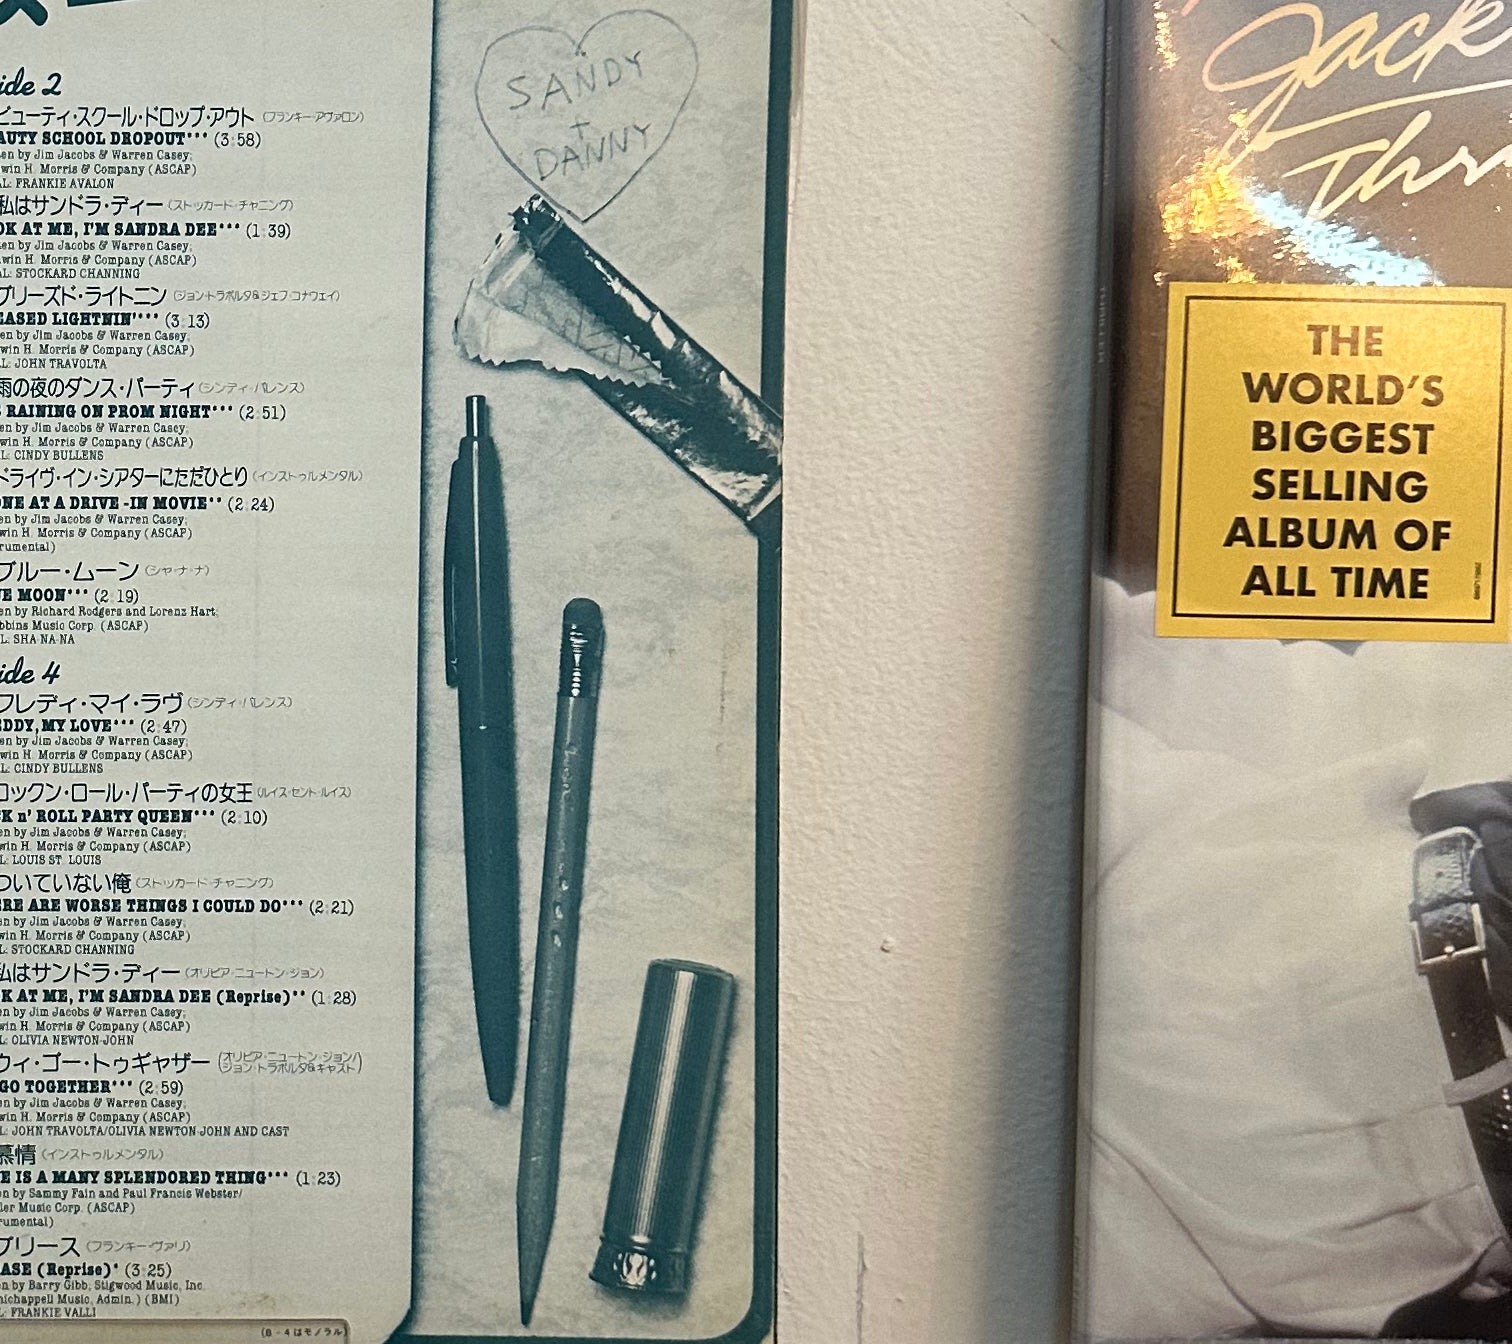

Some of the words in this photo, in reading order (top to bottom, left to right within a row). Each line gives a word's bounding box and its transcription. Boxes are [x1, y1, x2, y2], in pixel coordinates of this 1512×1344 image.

[42, 73, 63, 96] 2
[506, 49, 644, 111] SANDY
[42, 132, 106, 145] SCHOOL
[532, 122, 651, 182] DANNY
[1306, 324, 1383, 357] THE
[1241, 371, 1444, 407] WORLD'S
[6, 404, 76, 418] RAINING
[81, 404, 103, 418] ON
[107, 404, 154, 418] PROM
[1251, 420, 1435, 455] BIGGEST
[14, 450, 49, 461] CINDY
[52, 450, 104, 461] BULLENS
[1251, 468, 1429, 504] SELLING
[1222, 516, 1377, 551] ALBUM
[1393, 518, 1452, 552] OF
[1240, 564, 1317, 598] ALL
[1330, 566, 1430, 600] TIME
[42, 662, 61, 684] 4
[42, 719, 66, 732] MY
[15, 1171, 32, 1184] IS
[37, 1171, 47, 1184] A
[52, 1171, 99, 1184] MANY
[103, 1171, 210, 1184] SPLENDORED
